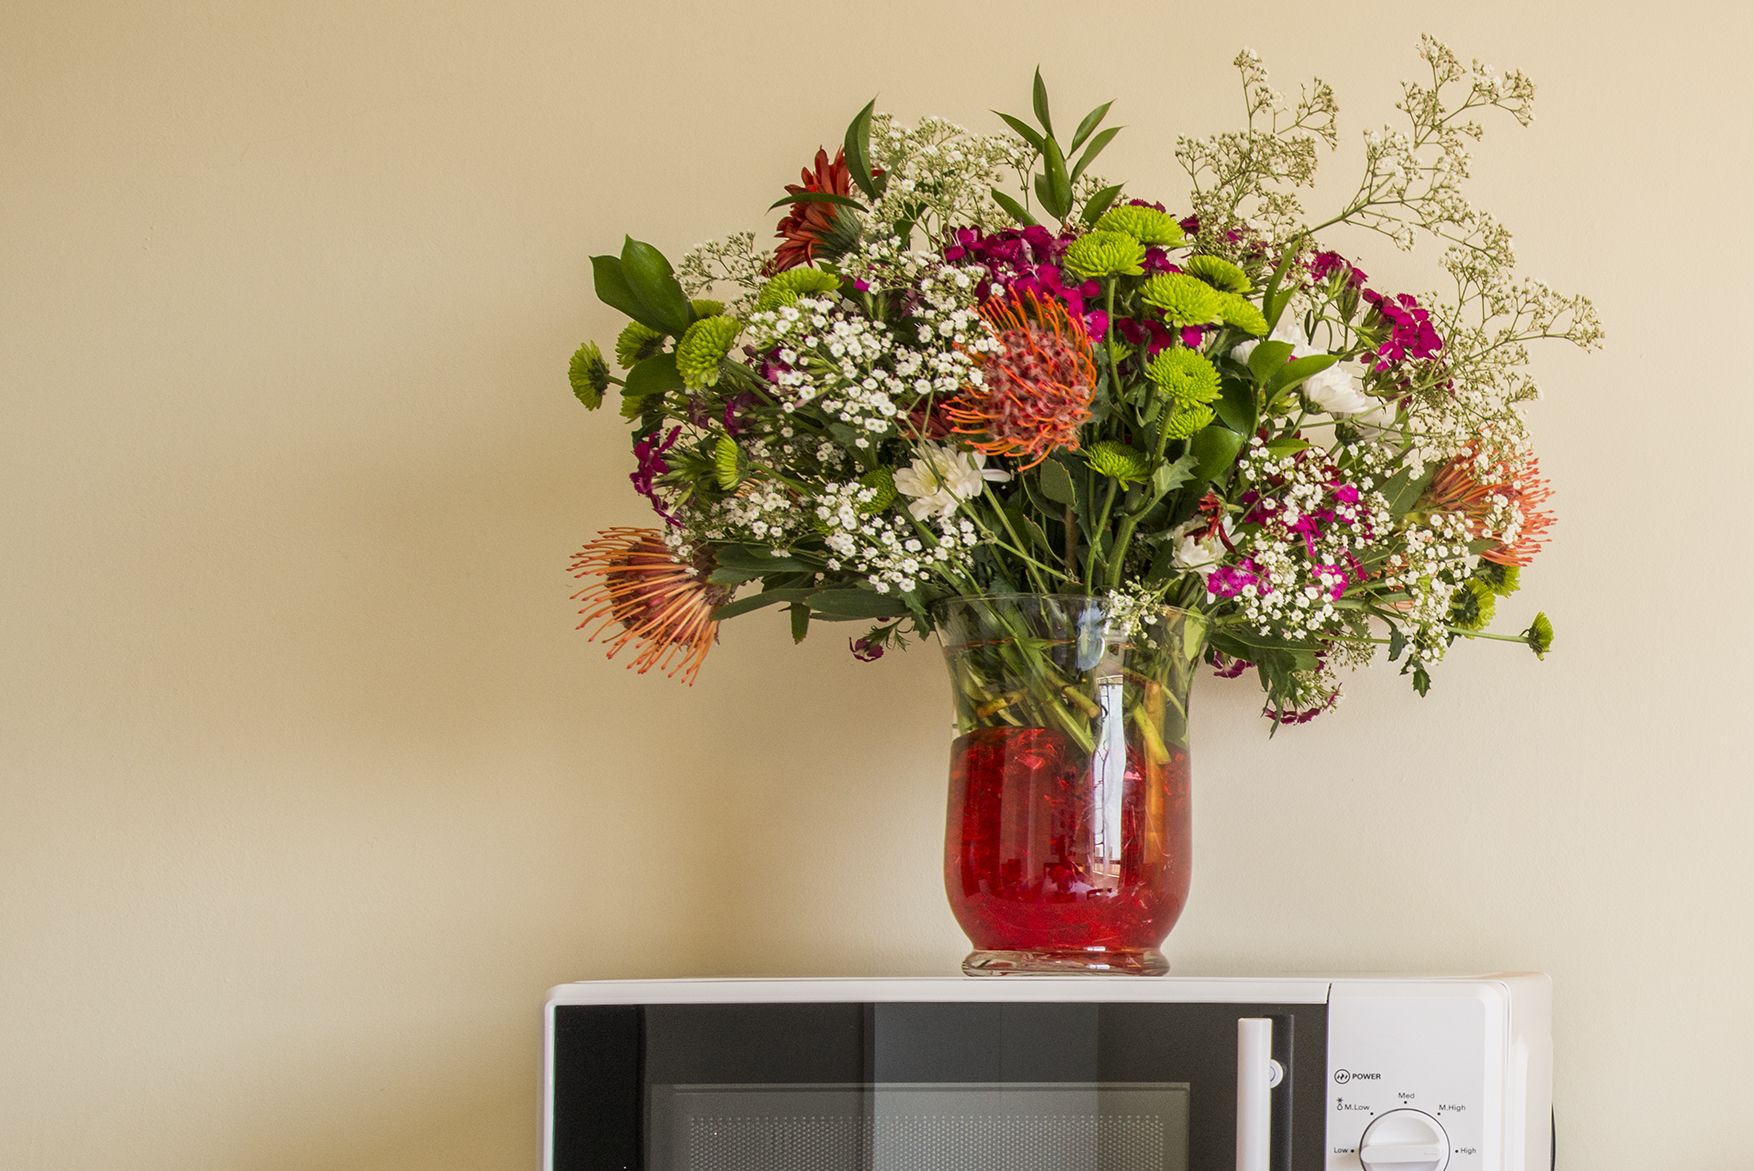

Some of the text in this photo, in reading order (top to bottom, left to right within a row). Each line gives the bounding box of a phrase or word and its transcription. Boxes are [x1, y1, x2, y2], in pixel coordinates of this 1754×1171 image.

[1351, 1072, 1382, 1081] POWER
[1397, 1092, 1416, 1100] Med
[1343, 1103, 1371, 1111] M.Low
[1438, 1103, 1467, 1113] M.High
[1333, 1147, 1349, 1155] Low
[1460, 1147, 1477, 1156] High
